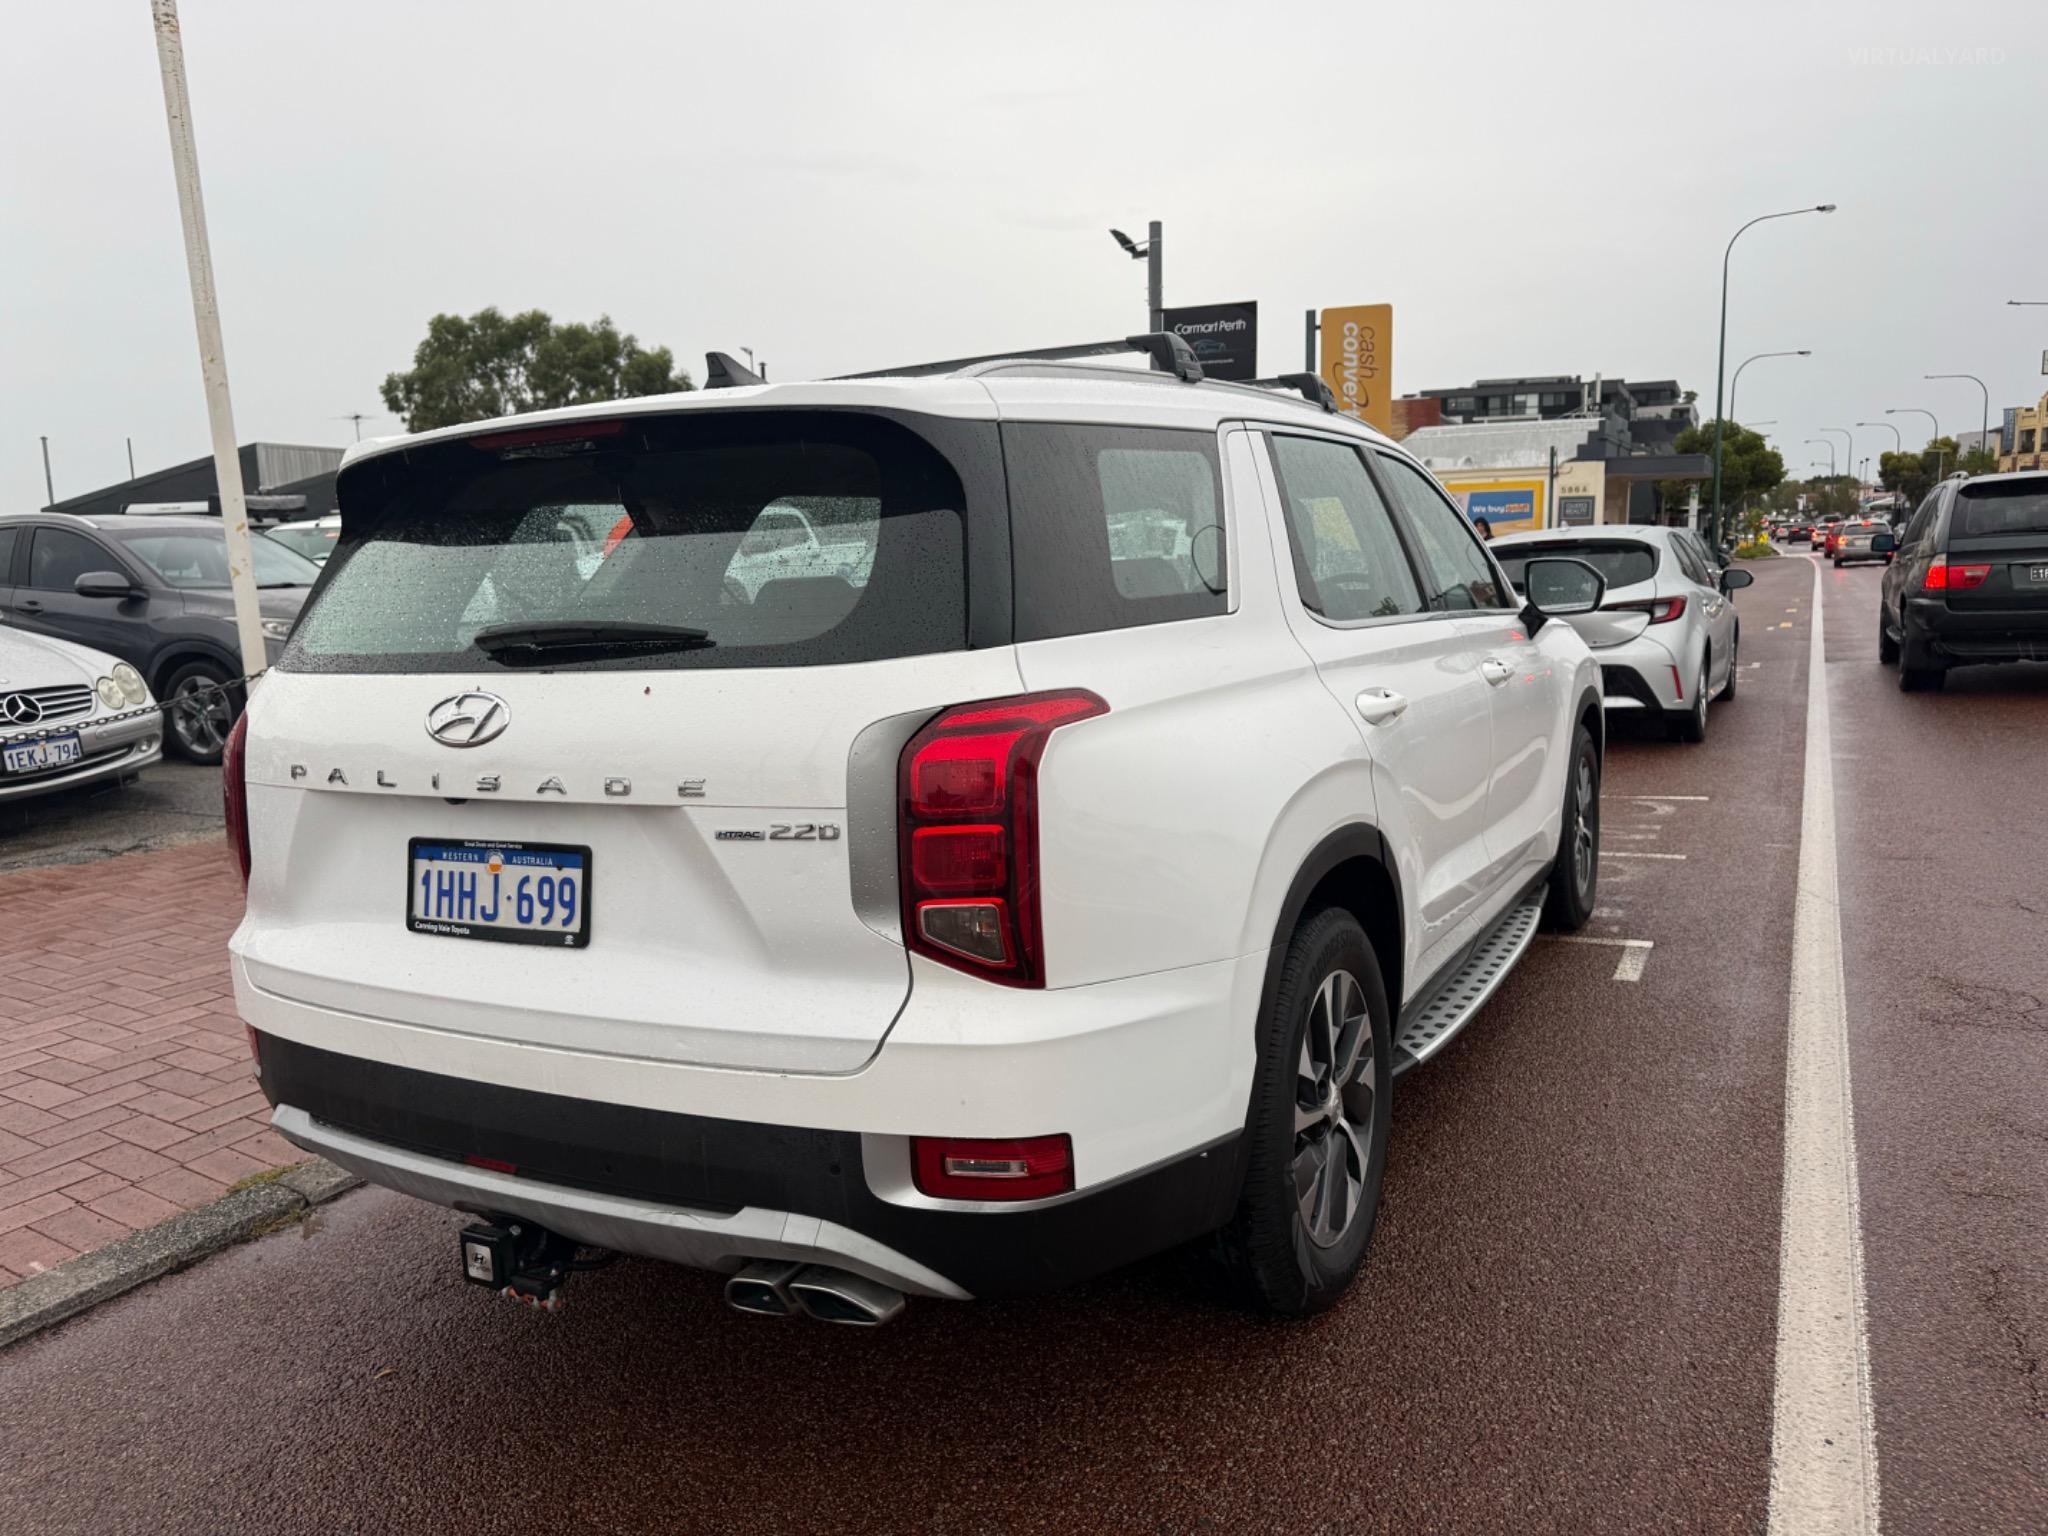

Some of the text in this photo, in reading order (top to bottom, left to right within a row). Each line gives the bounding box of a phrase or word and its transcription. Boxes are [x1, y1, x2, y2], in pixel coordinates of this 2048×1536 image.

[1174, 318, 1247, 335] Carmart Perth
[1359, 326, 1379, 379] cash
[291, 763, 706, 798] PALISADE
[716, 830, 765, 840] HTRAC
[442, 851, 553, 866] WESTERN AUSTRALIA
[415, 921, 470, 935] Canning Vale Toyota
